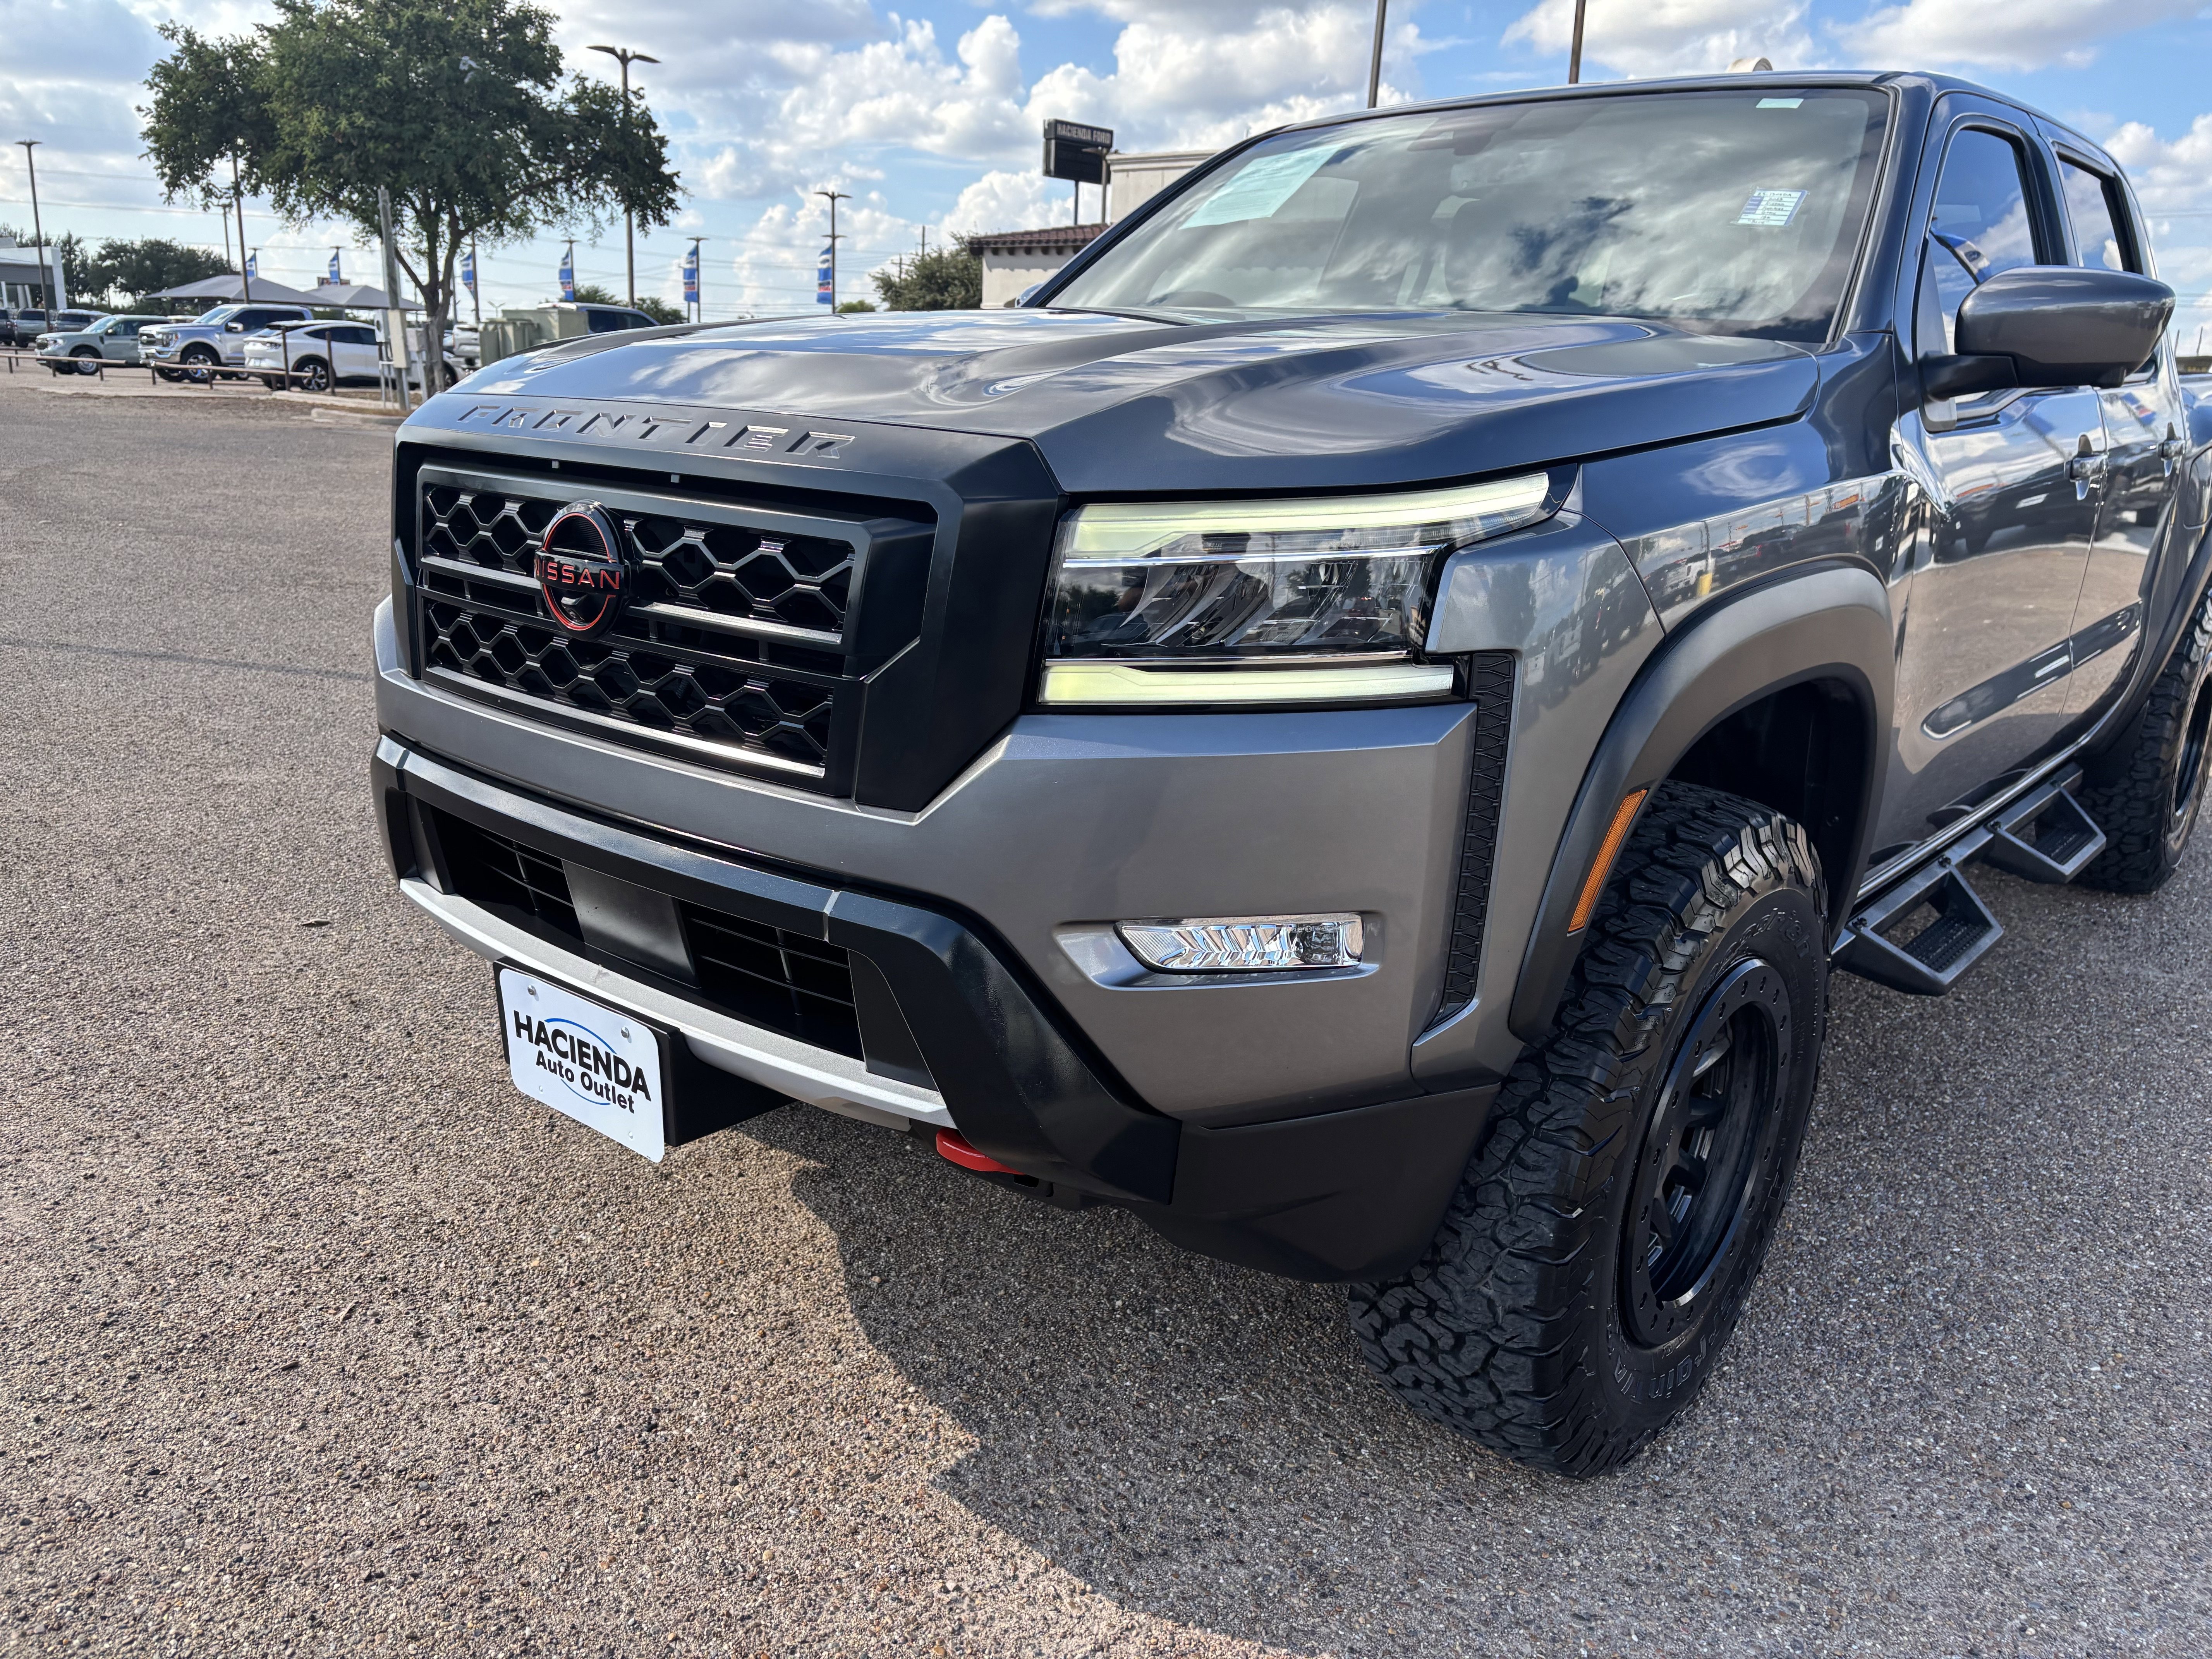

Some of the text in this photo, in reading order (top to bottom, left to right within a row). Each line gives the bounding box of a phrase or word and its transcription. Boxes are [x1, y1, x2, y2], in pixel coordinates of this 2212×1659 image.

[457, 404, 857, 459] FRONTIER
[513, 1010, 652, 1102] HACIENDA
[536, 1050, 635, 1114] Auto Outlet
